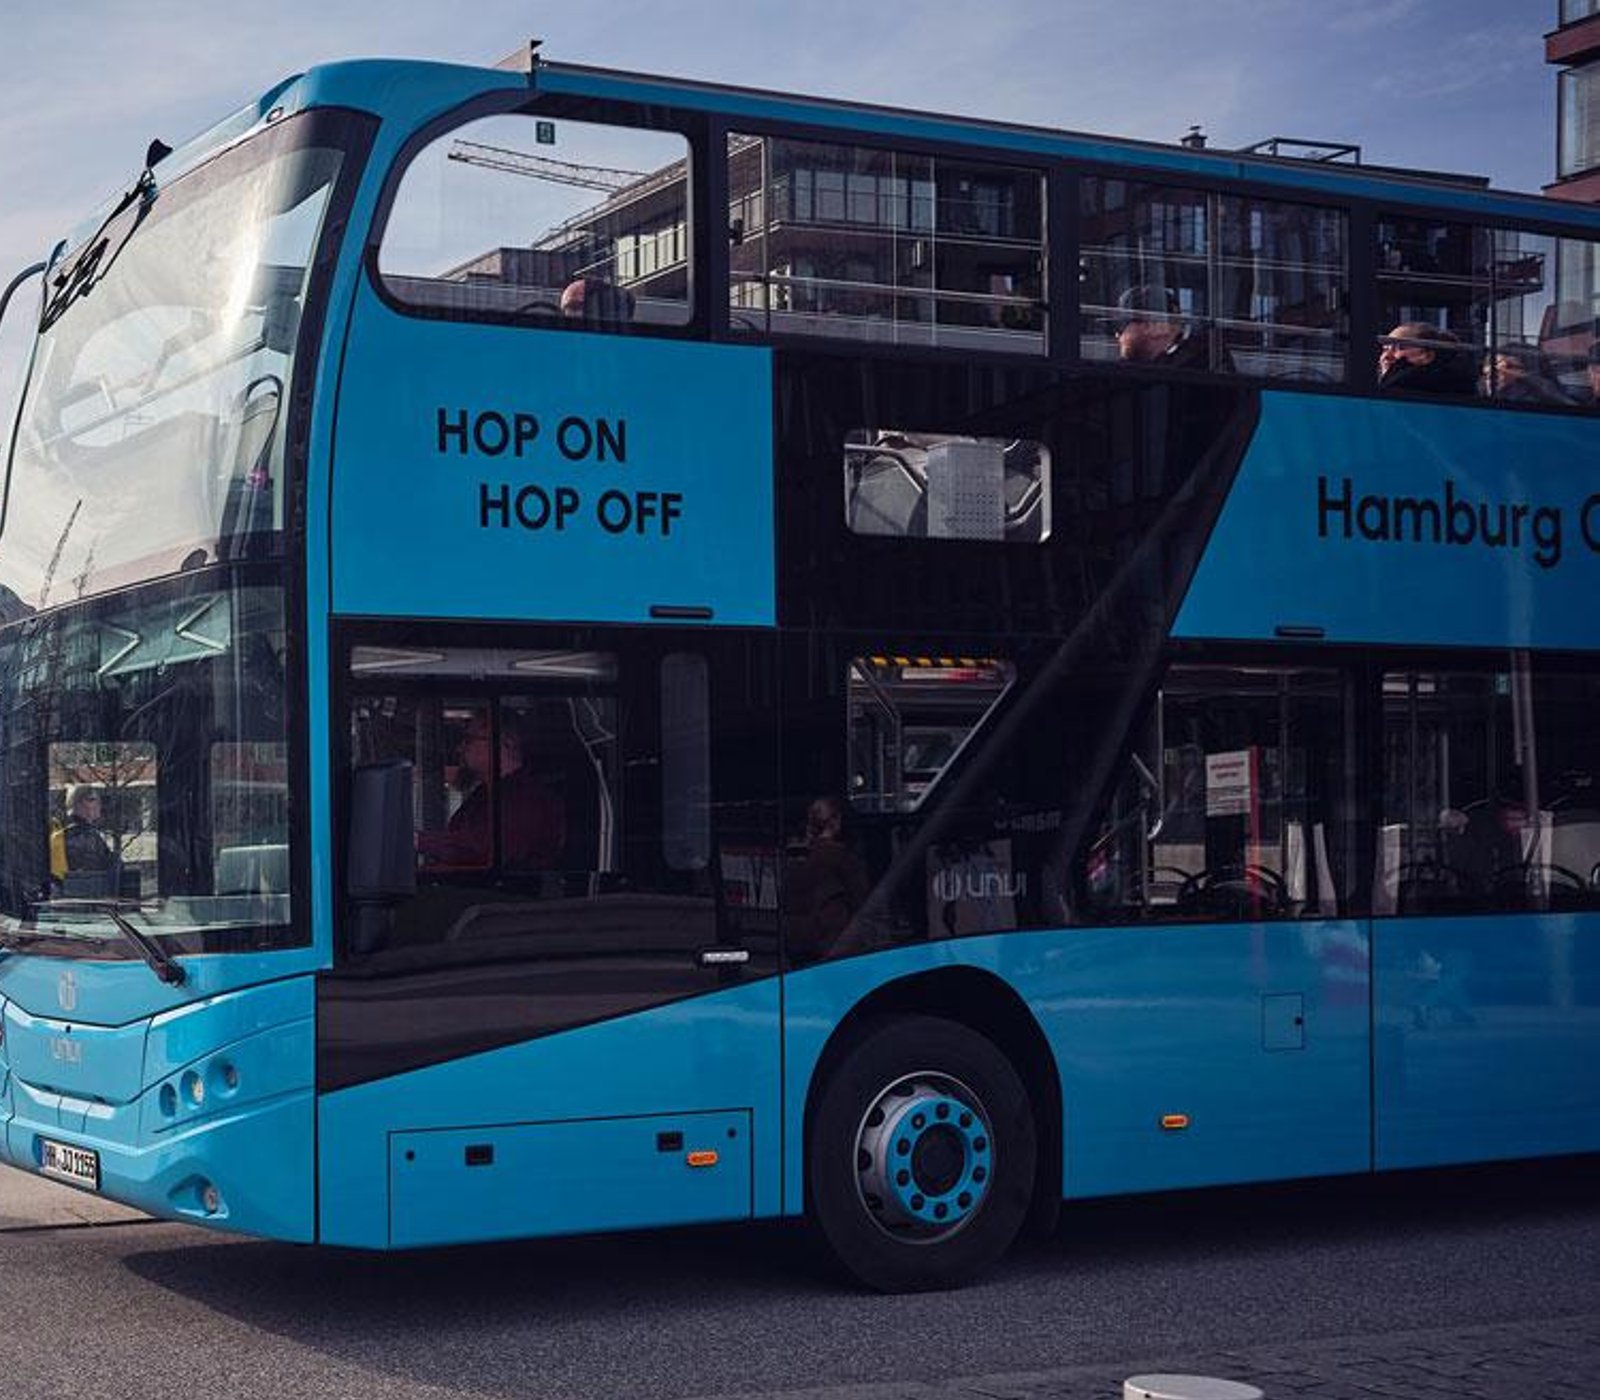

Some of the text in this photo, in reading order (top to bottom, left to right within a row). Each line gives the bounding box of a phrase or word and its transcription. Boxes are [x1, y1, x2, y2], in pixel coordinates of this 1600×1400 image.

[437, 408, 627, 463] HOP ON
[479, 483, 683, 536] HOP OFF
[1317, 475, 1562, 568] Hamburg
